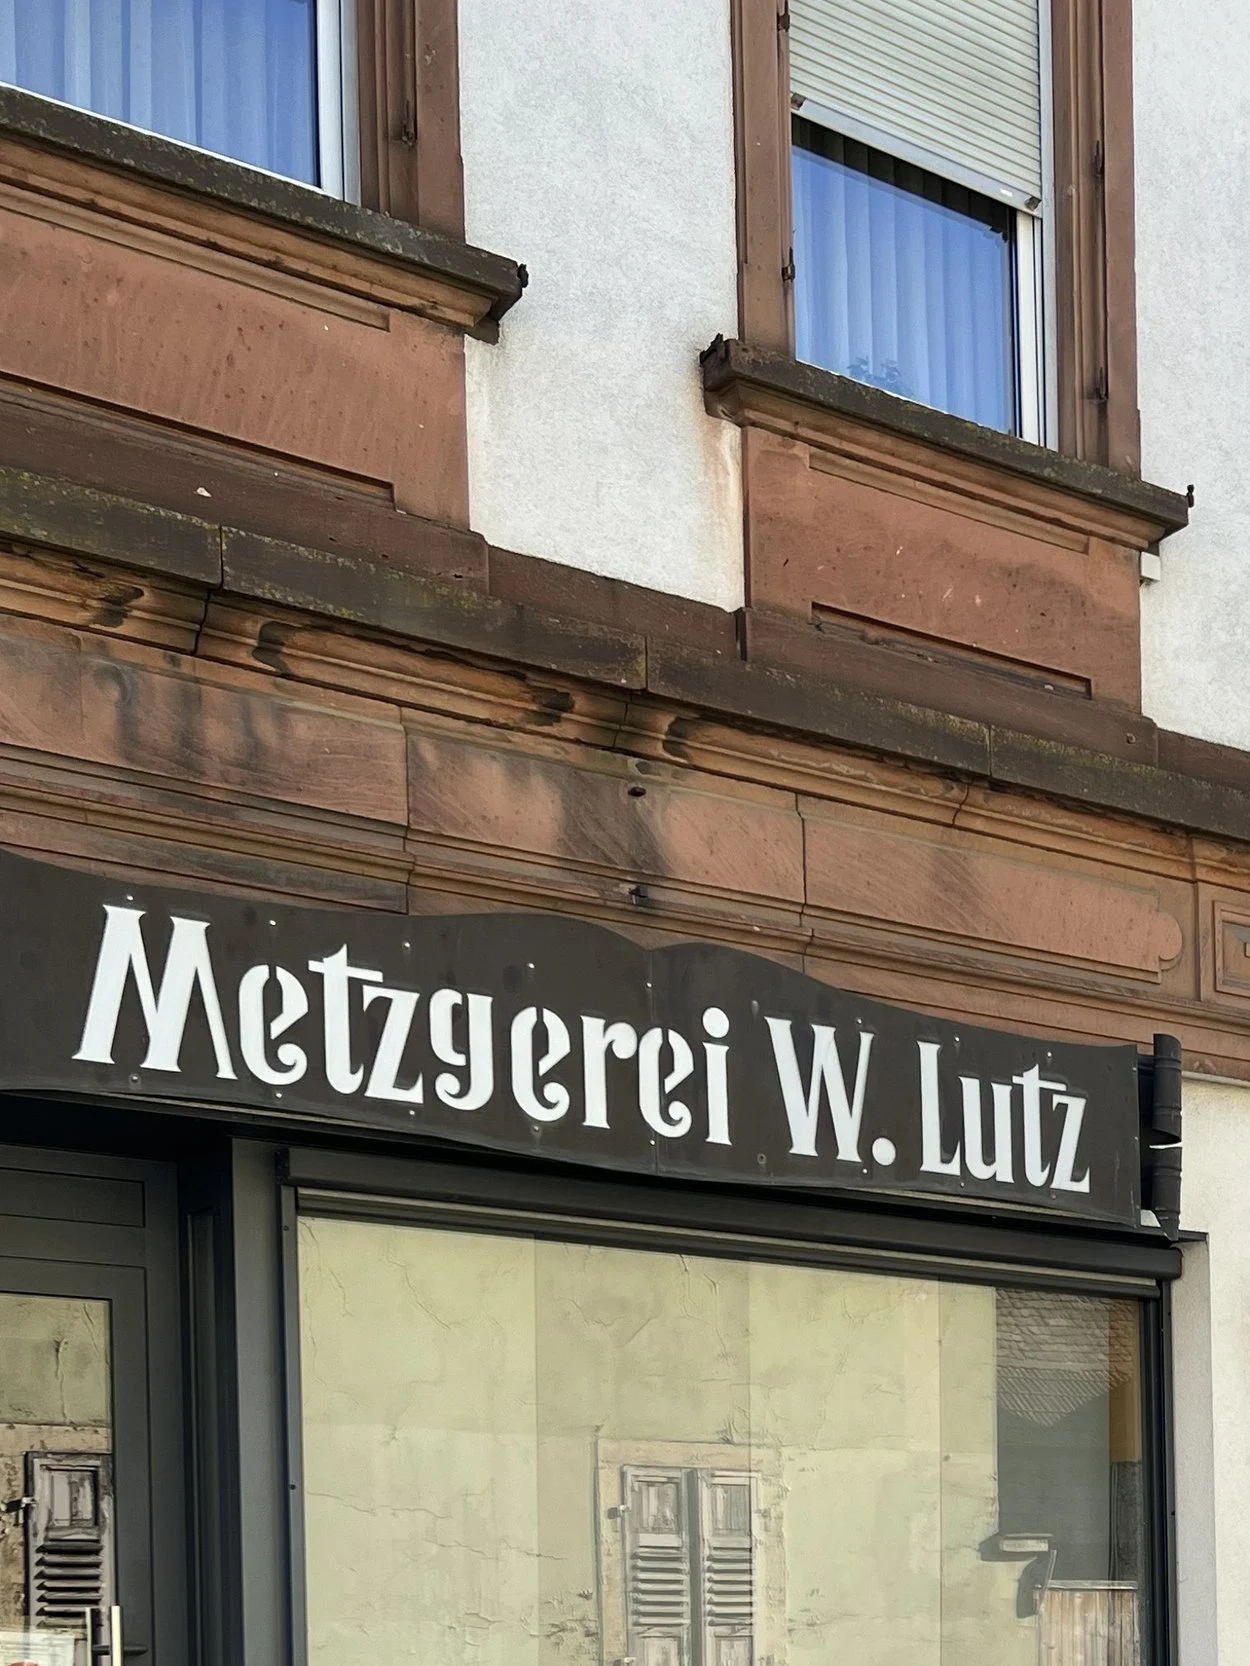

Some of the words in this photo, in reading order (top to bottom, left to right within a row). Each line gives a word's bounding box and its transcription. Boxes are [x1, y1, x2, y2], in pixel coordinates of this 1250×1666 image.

[72, 905, 732, 1146] Metzgerei
[764, 1016, 896, 1166] W.
[917, 1041, 1090, 1193] Lutz
